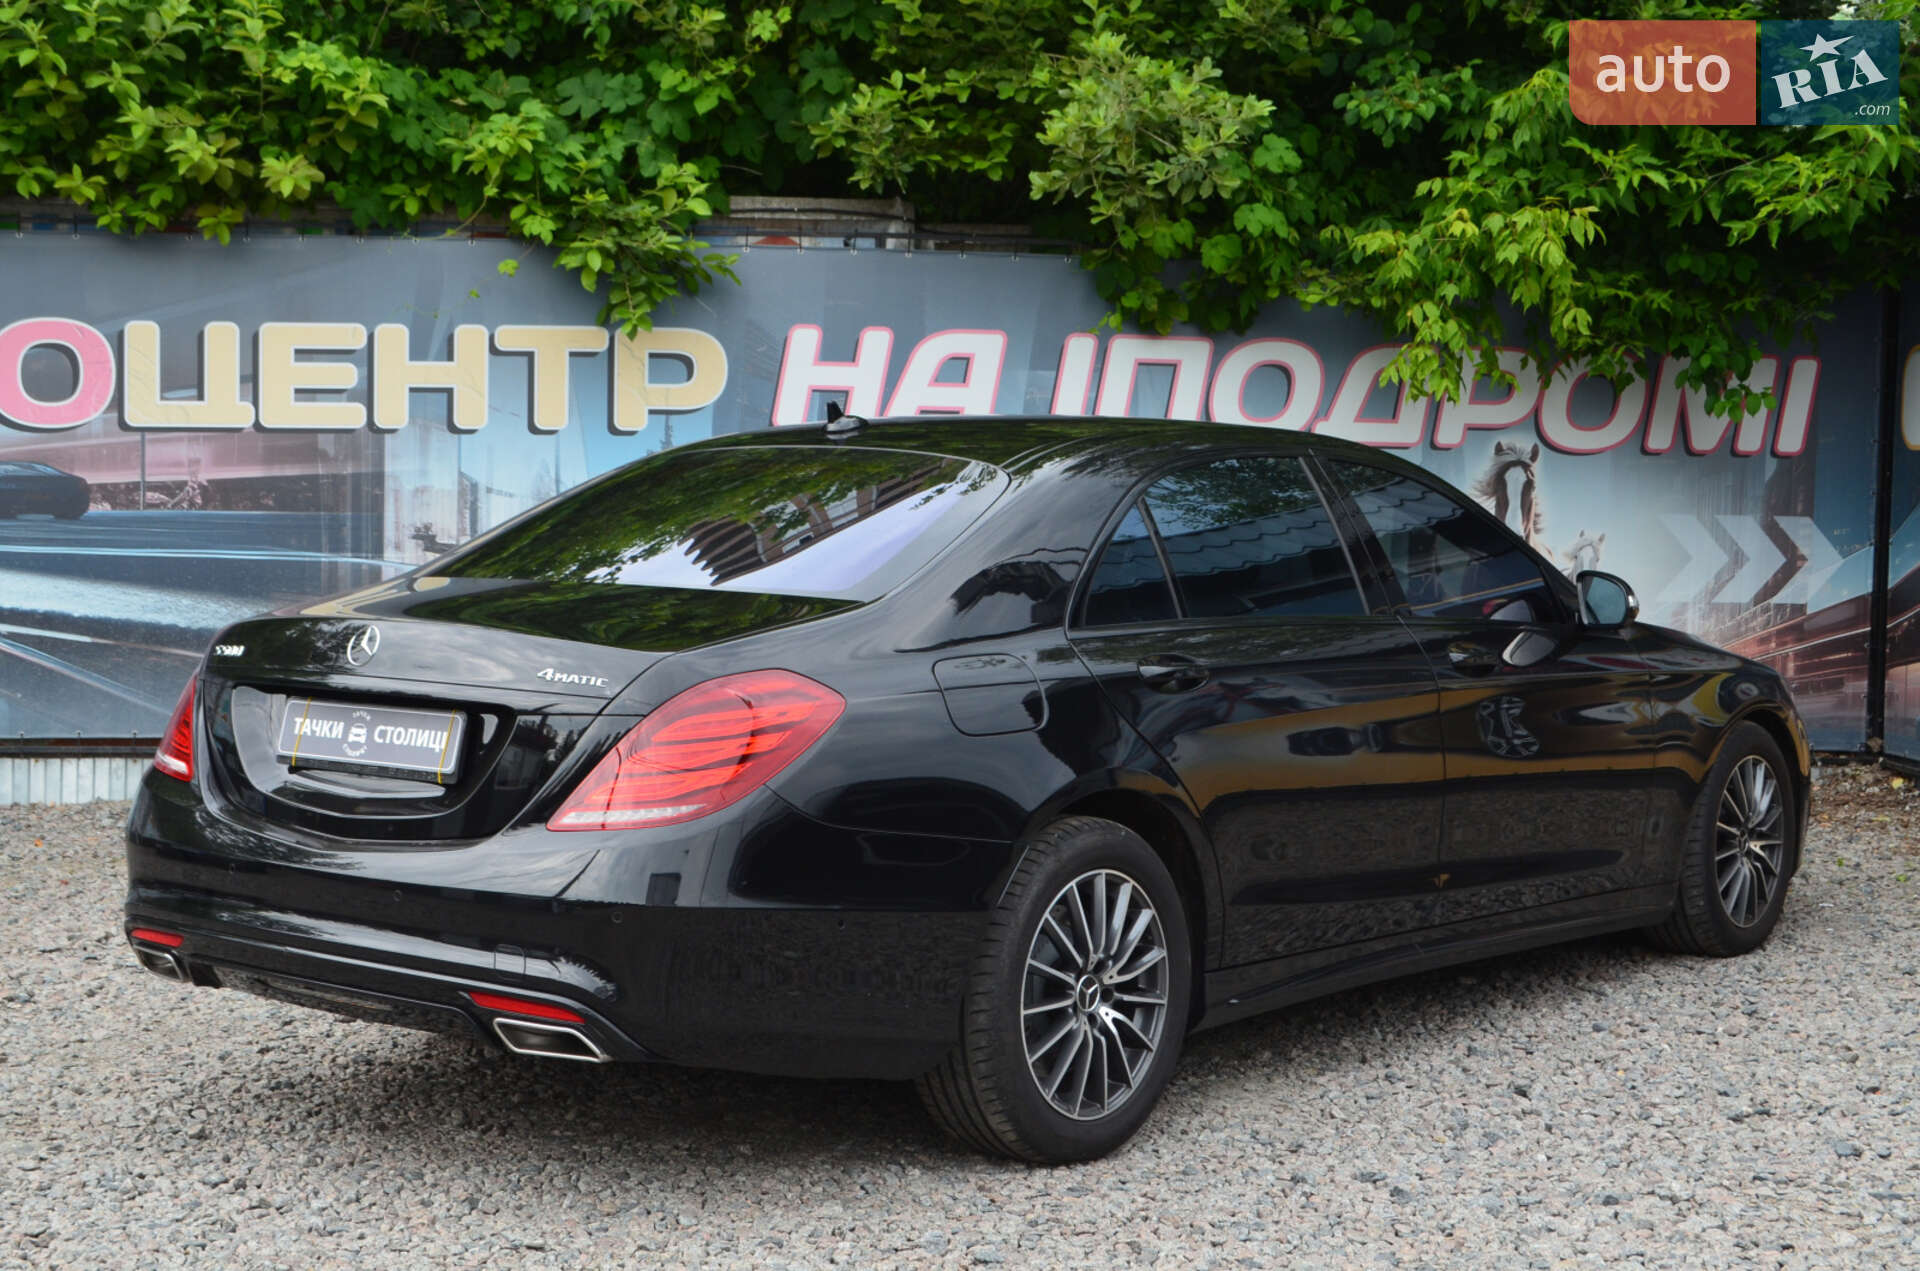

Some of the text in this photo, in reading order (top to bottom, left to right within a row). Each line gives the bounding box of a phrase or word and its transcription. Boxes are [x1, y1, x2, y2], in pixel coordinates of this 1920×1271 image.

[0, 317, 728, 433] ОЦЕНТР
[770, 323, 1008, 426] НА
[537, 667, 609, 688] 4MATIC
[293, 717, 345, 739] ТАЧКИ
